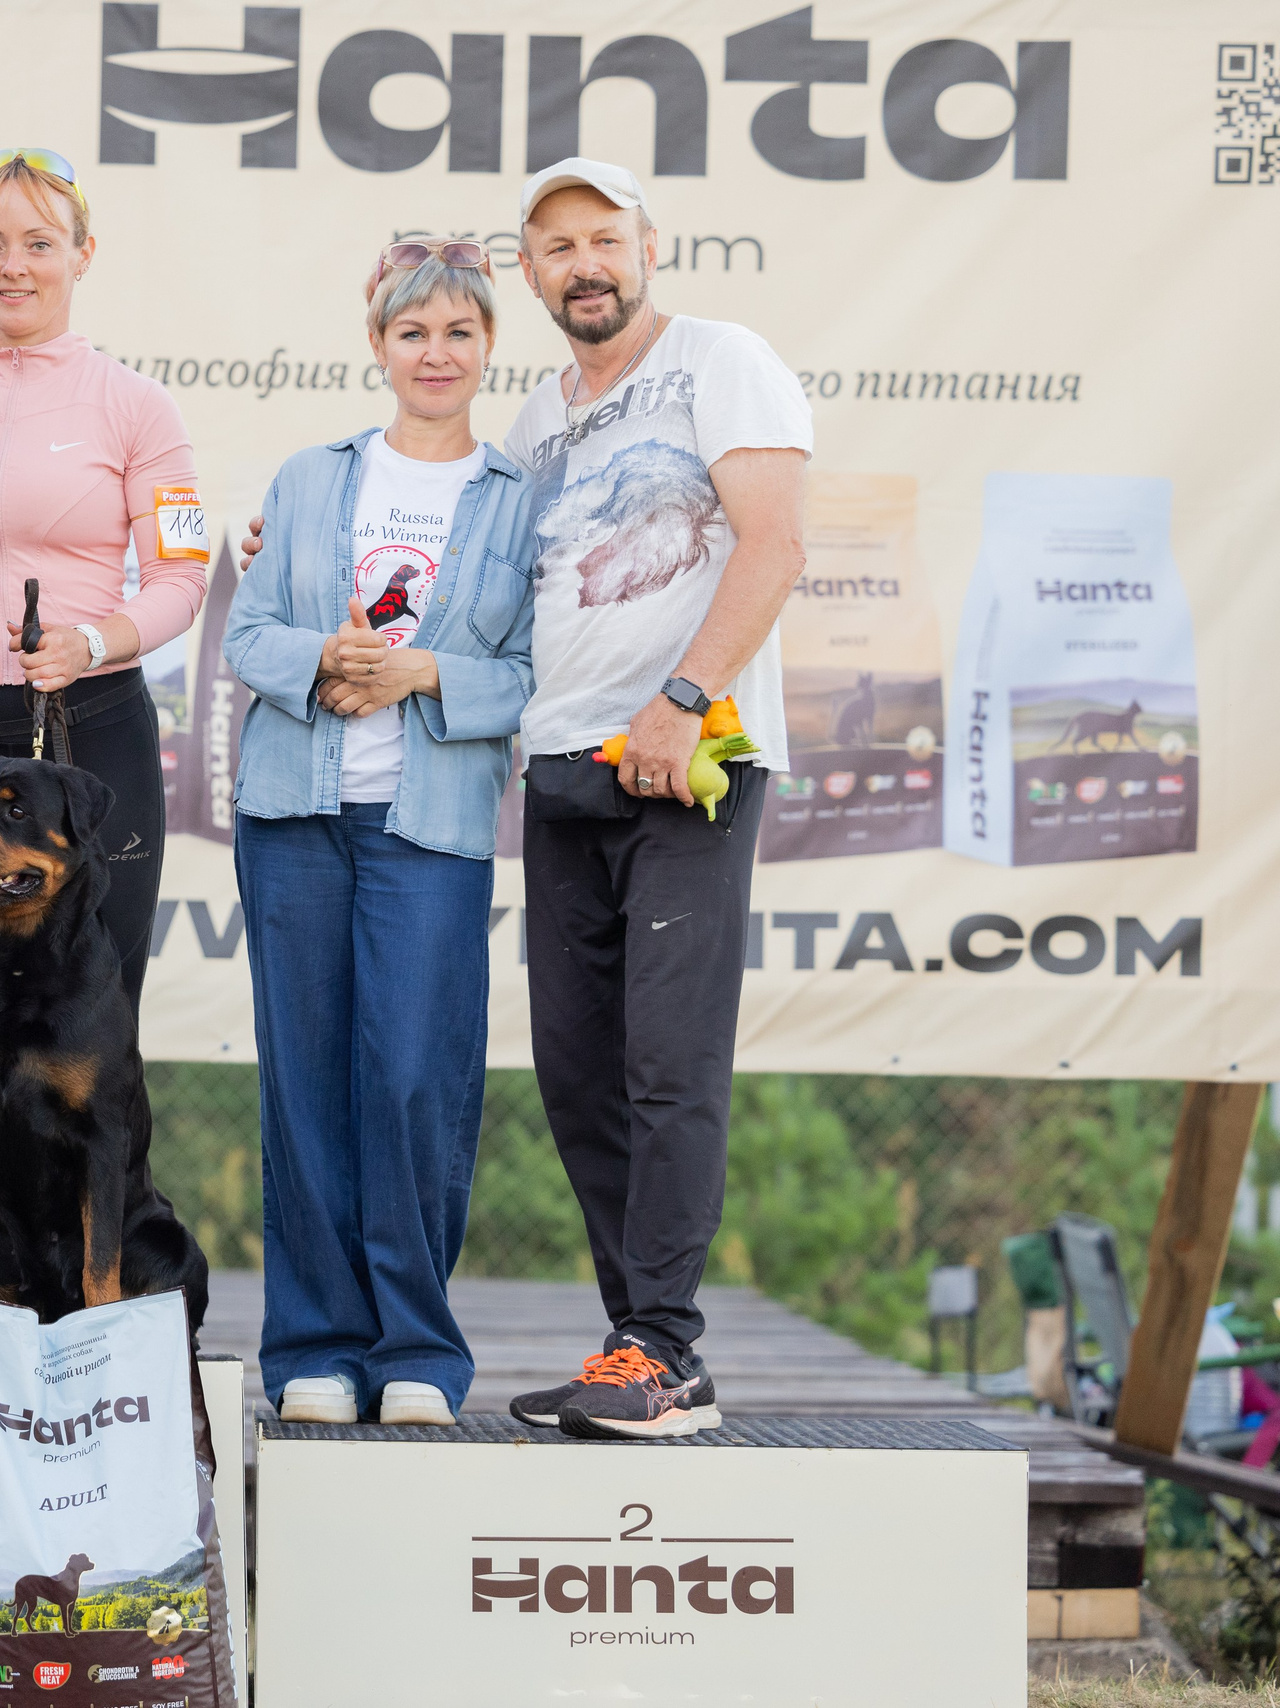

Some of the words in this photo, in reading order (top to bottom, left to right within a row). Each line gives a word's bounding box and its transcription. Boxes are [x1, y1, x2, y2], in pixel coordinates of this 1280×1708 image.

[98, 2, 1071, 181] Hanta
[855, 370, 1082, 401] питания
[169, 507, 204, 538] 118
[389, 508, 444, 526] Russia
[381, 525, 449, 544] Winner
[1034, 577, 1154, 603] Hanta
[969, 690, 990, 840] Hanta
[108, 850, 151, 861] DEMIX
[72, 1347, 94, 1359] собак
[84, 1353, 112, 1376] рисом
[43, 1440, 101, 1464] premium
[39, 1483, 108, 1512] ADULT
[619, 1502, 654, 1541] 2
[472, 1554, 795, 1615] Hanta
[570, 1626, 695, 1648] premium
[40, 1666, 65, 1676] FRESH
[40, 1675, 61, 1685] MEAT
[98, 1672, 138, 1681] GLUCOSAMINE
[166, 1700, 185, 1708] FREE
